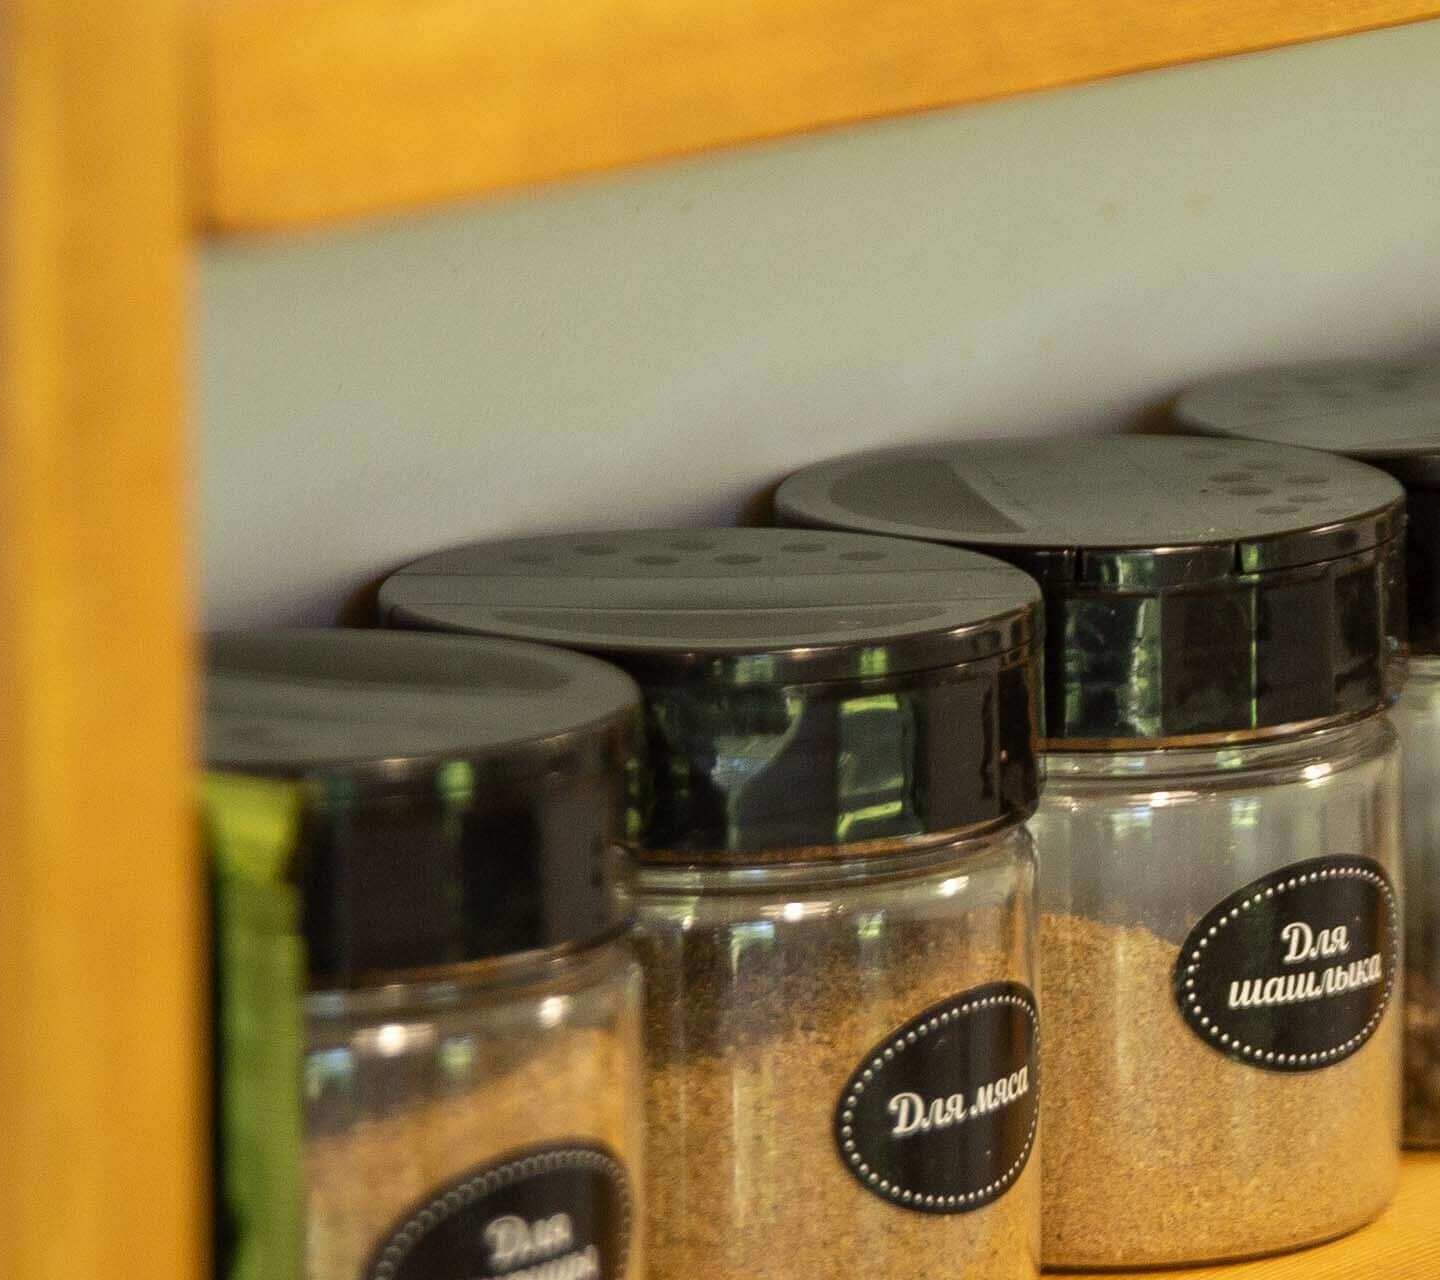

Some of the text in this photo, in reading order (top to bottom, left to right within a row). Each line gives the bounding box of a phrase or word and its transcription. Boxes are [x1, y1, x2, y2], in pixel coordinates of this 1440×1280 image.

[1281, 921, 1351, 965] Для
[1227, 951, 1382, 1010] шашлыка
[887, 1064, 1029, 1139] Для мяса
[483, 1213, 574, 1271] Для
